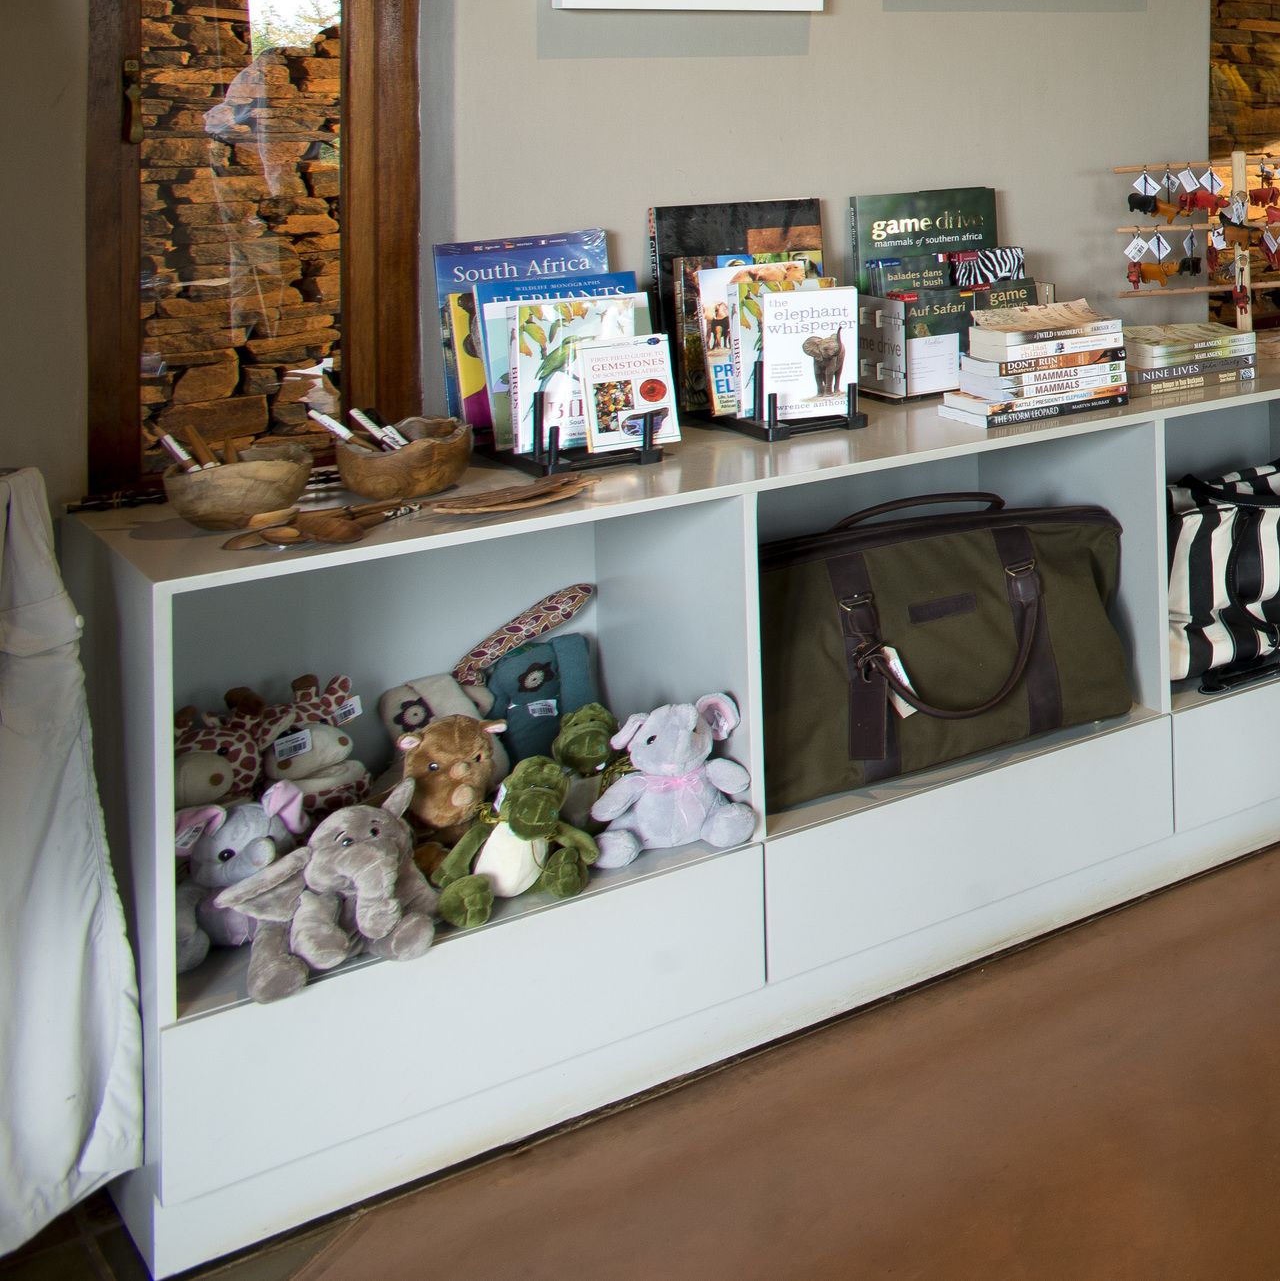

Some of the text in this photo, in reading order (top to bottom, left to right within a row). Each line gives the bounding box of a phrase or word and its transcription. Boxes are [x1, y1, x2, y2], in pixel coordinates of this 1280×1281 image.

[871, 210, 984, 240] game drive
[874, 232, 983, 248] mammals of southern africa
[453, 257, 592, 283] South Africa
[887, 269, 943, 282] balades dans
[551, 280, 601, 290] MONOGRAPHS
[912, 277, 943, 288] le bush
[769, 299, 788, 308] the
[989, 288, 1028, 306] game
[774, 305, 849, 322] elephant
[908, 302, 966, 317] Auf Safari
[767, 320, 857, 335] whisperer
[655, 350, 664, 358] TO
[877, 338, 902, 357] drive
[591, 358, 665, 373] GEMSTONES
[733, 338, 741, 379] BIRDS
[1007, 356, 1058, 370] DON'T RUN
[713, 364, 734, 379] PR
[1007, 367, 1036, 375] whatever
[1033, 368, 1079, 383] MAMMALS
[1143, 369, 1169, 381] NINE
[1173, 364, 1200, 376] LIVES
[716, 379, 735, 395] EL
[1035, 380, 1080, 395] MAMMALS
[777, 402, 811, 411] wrence
[569, 418, 585, 426] Sout
[994, 414, 1008, 424] THE
[1008, 411, 1031, 422] STORM
[1031, 406, 1059, 418] LEOPARD
